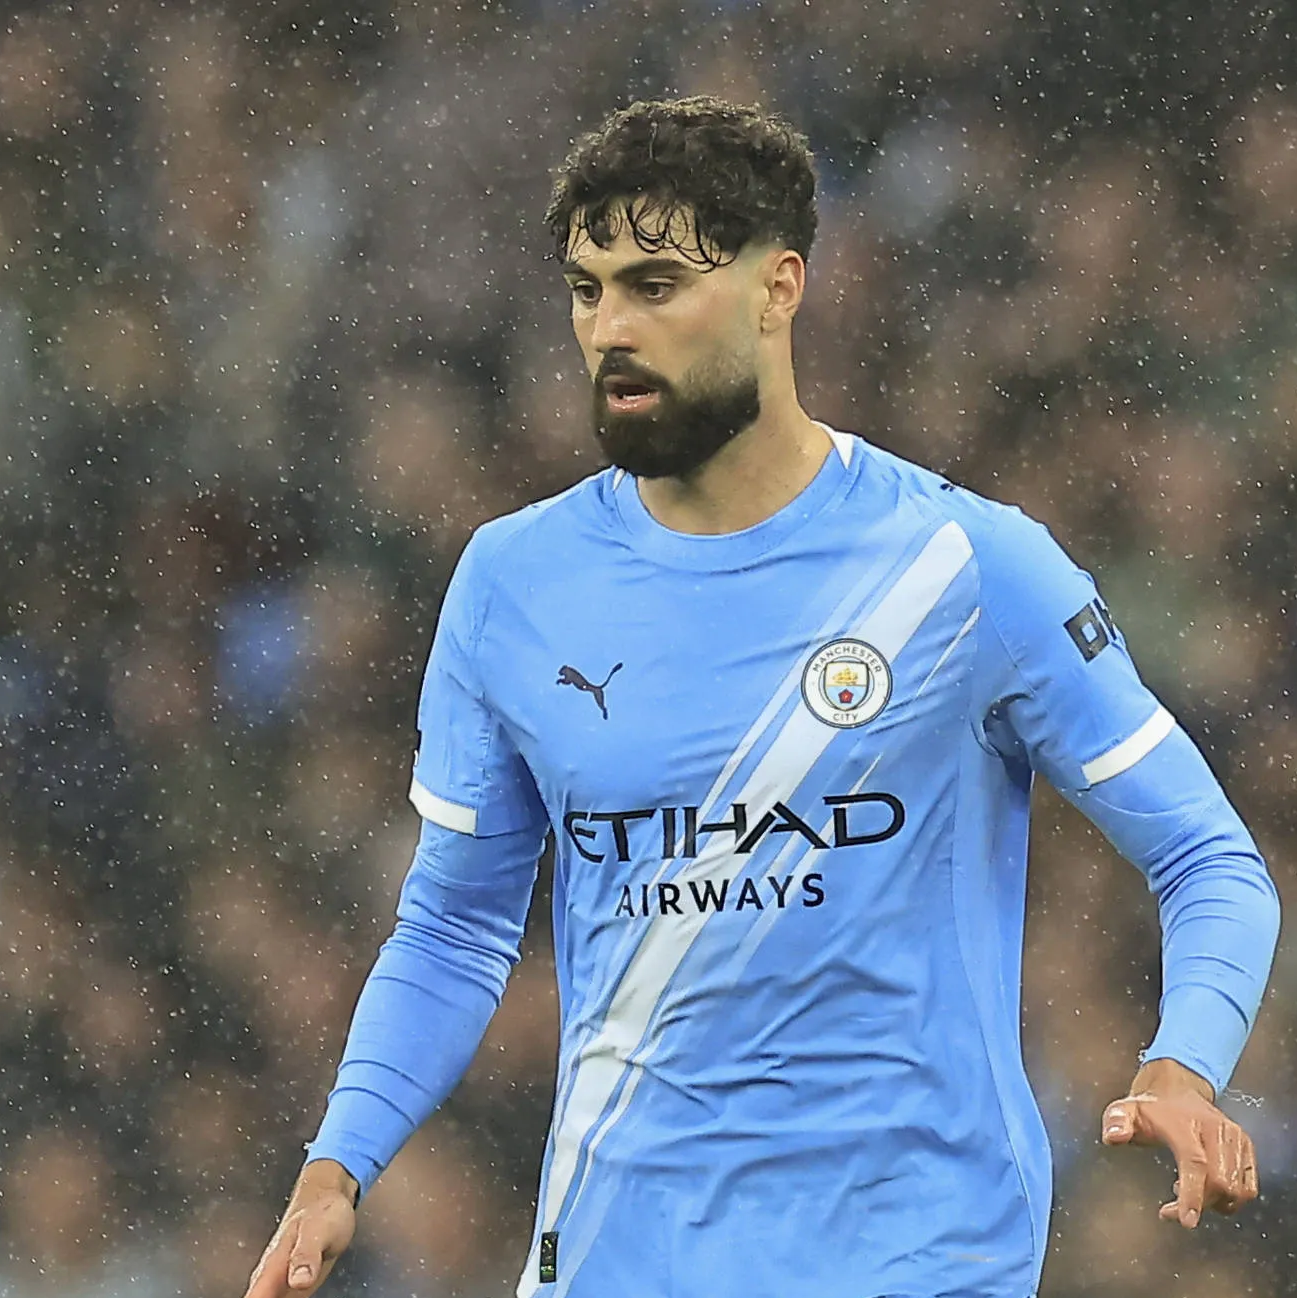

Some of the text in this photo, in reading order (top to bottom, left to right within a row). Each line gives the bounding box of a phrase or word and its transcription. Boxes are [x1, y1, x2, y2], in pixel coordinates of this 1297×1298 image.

[812, 645, 882, 673] MANCHESTER
[833, 712, 859, 721] CITY
[563, 791, 906, 863] ETIHAD
[614, 873, 826, 918] AIRWAYS
